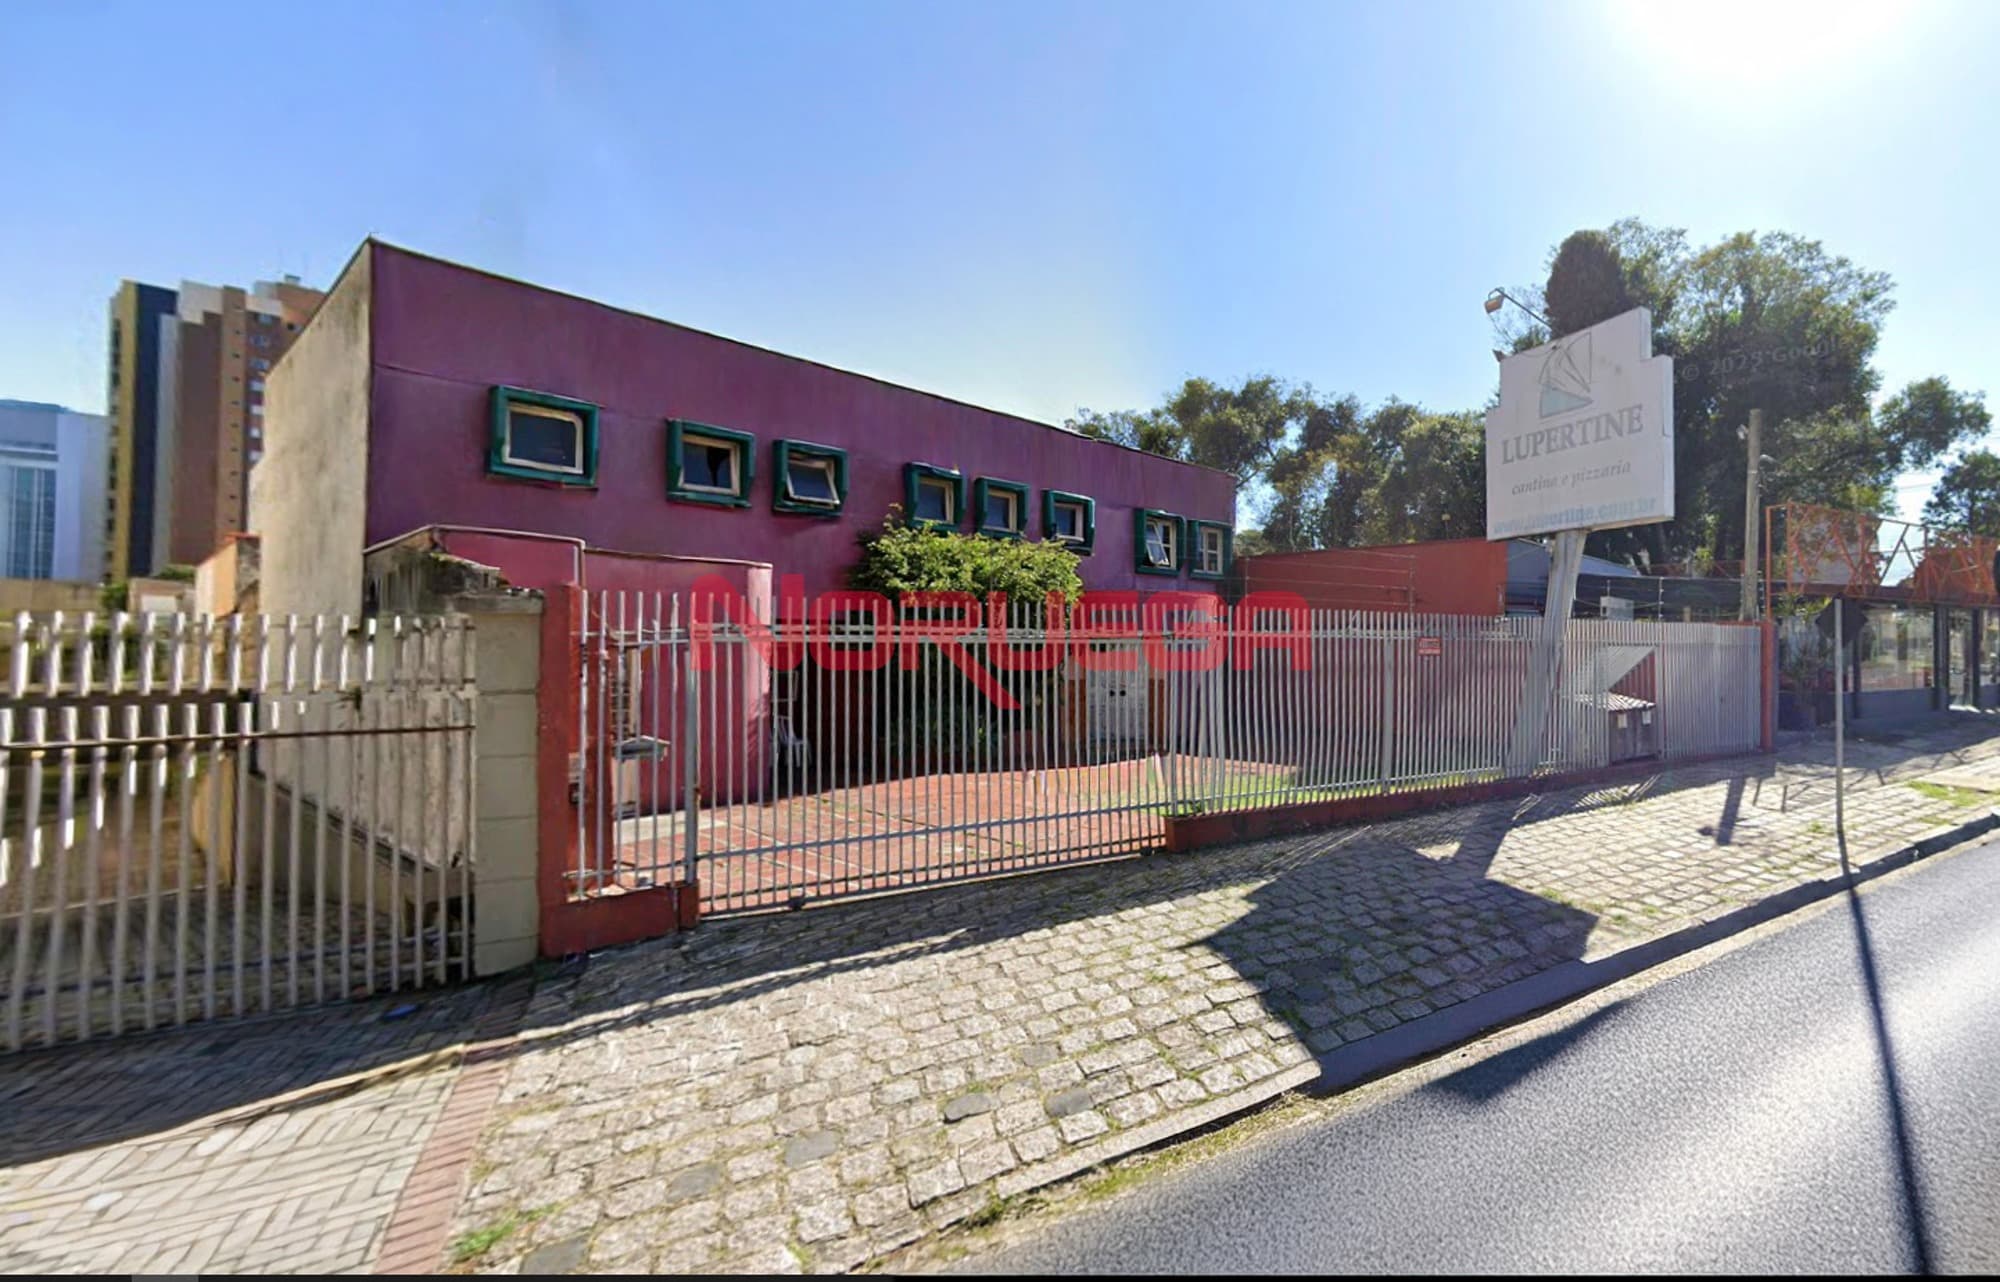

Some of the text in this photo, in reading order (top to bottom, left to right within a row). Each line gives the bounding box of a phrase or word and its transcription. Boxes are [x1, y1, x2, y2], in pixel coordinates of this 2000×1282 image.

[1502, 404, 1644, 465] LUPERTINE
[1511, 459, 1631, 496] cantina e pizzaria
